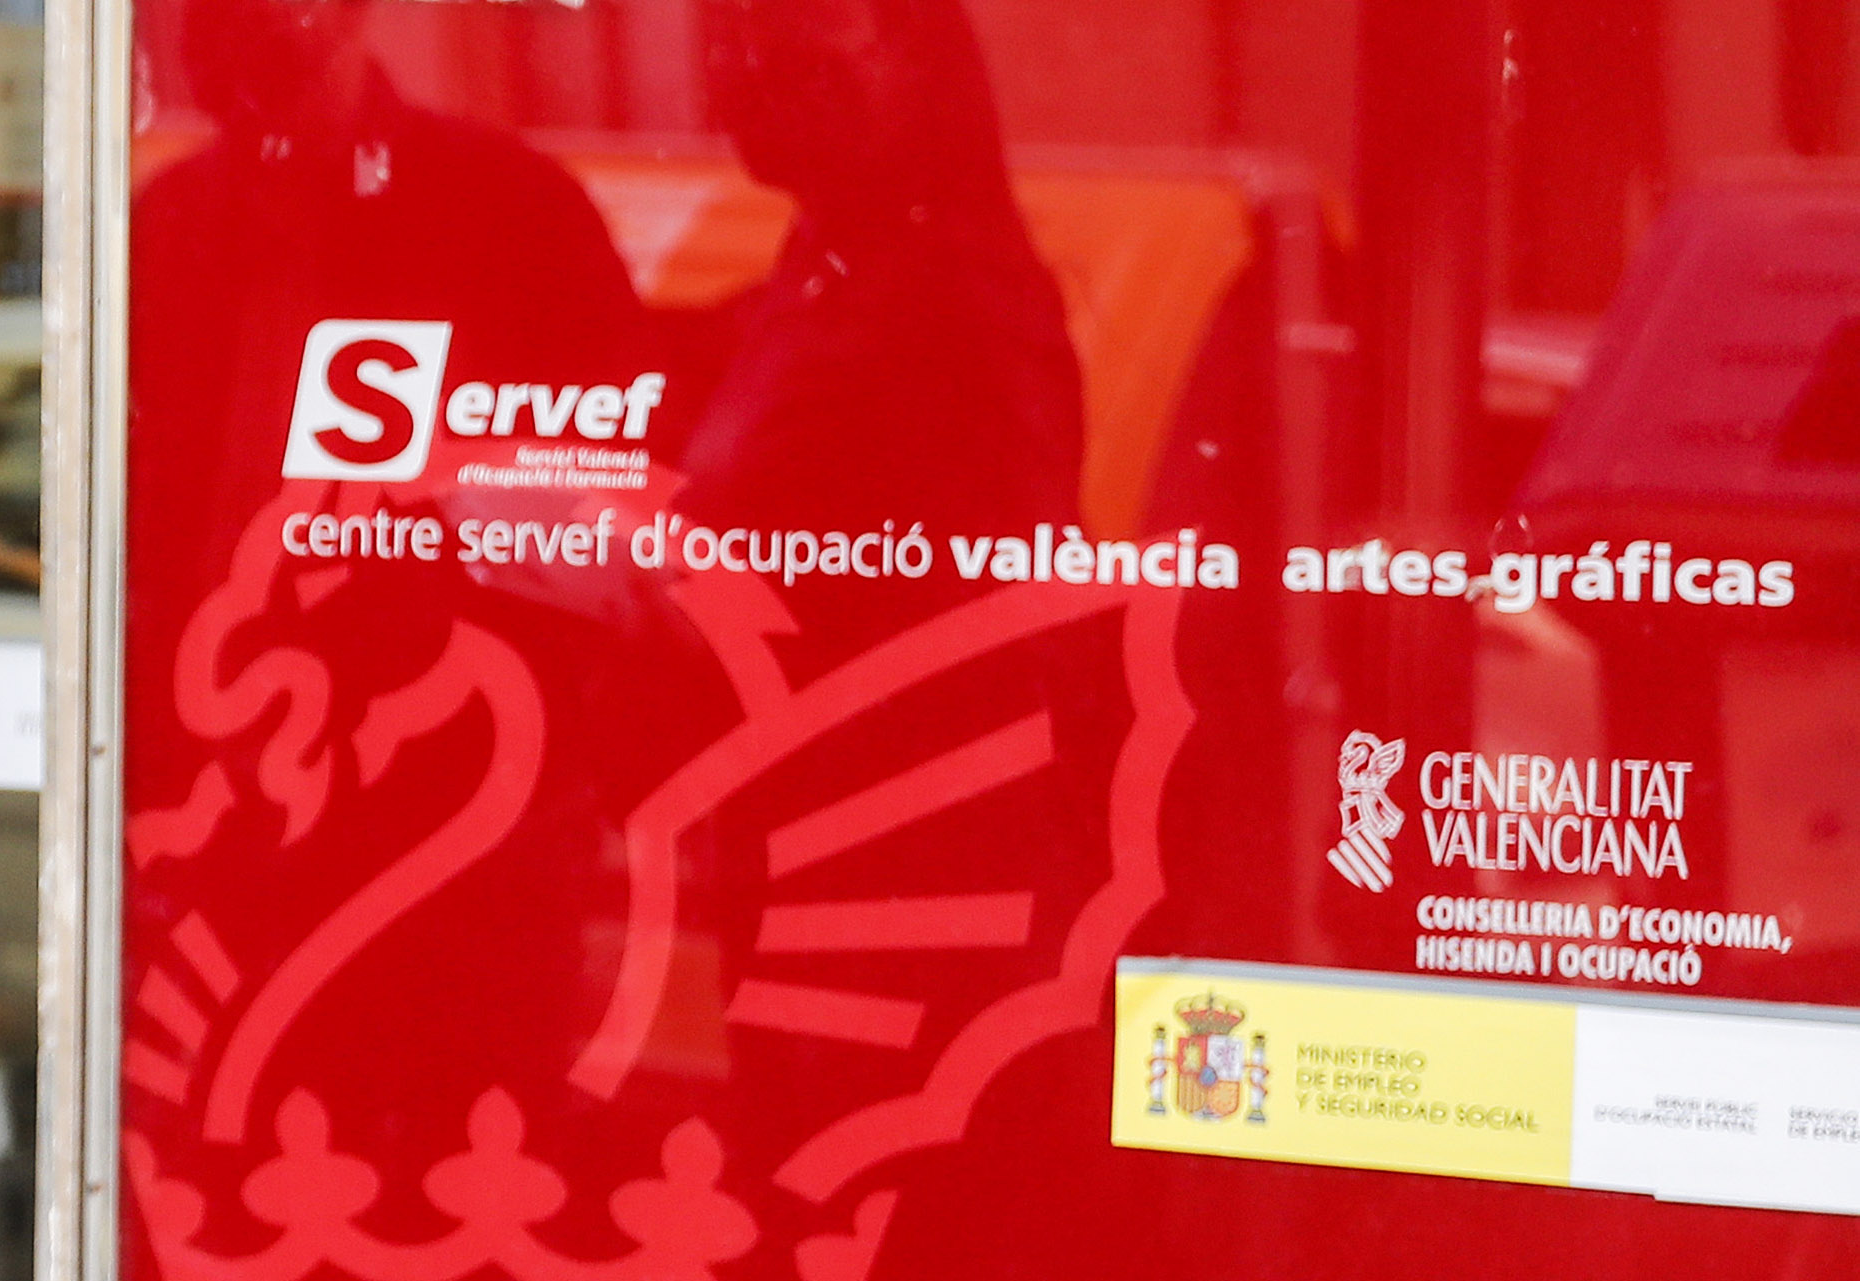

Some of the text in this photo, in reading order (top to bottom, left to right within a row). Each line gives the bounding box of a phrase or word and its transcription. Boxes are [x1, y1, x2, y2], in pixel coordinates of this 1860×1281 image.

[312, 338, 666, 464] Servef
[283, 508, 1795, 613] centre servef d'ocupació valència artes gráficas
[1419, 751, 1692, 820] GENERALITAT
[1421, 810, 1689, 880] VALENCIANA
[1416, 894, 1791, 955] CONSELLERIA D'ECONOMIA,
[1416, 933, 1701, 986] HISENDA I OCUPACIÓ
[1296, 1043, 1427, 1073] MINISTERIO
[1296, 1067, 1421, 1097] DE EMPLEO
[1297, 1092, 1542, 1133] Y SEGURIDAD SOCIAL
